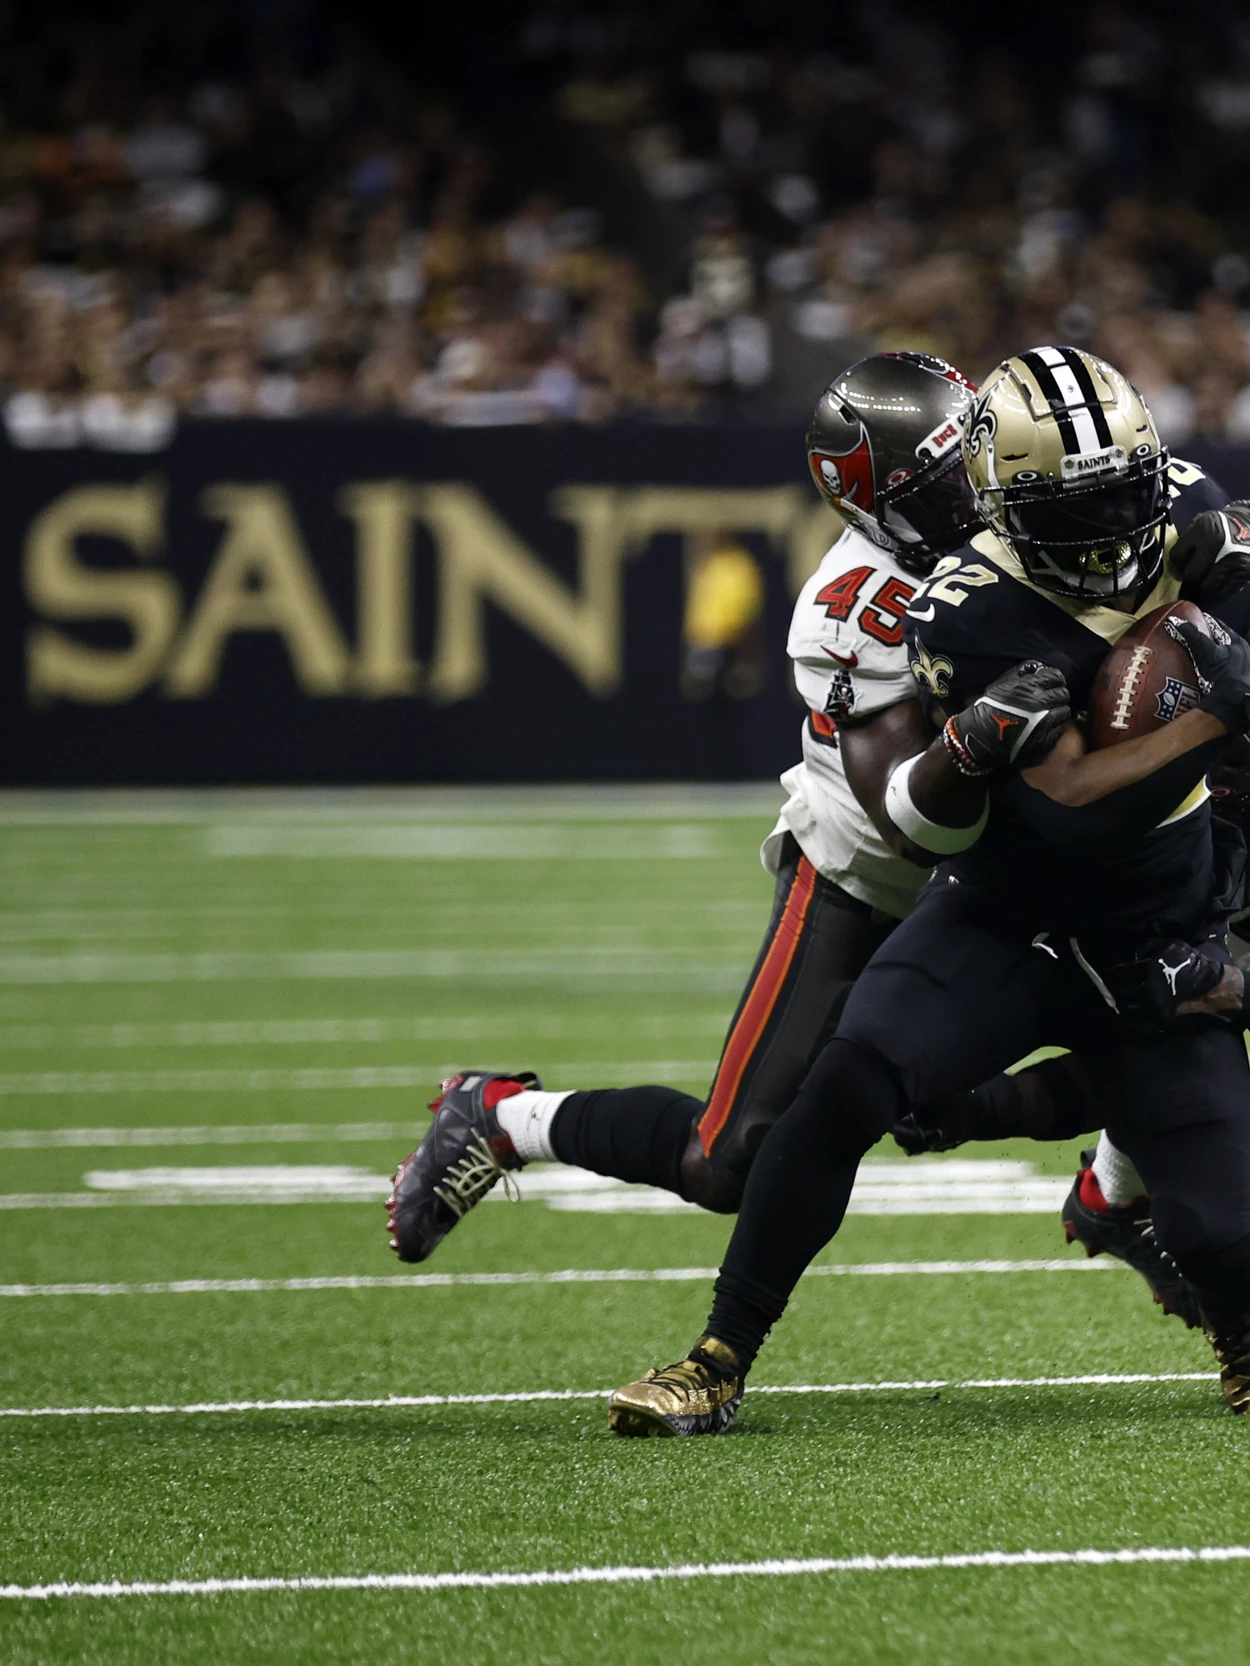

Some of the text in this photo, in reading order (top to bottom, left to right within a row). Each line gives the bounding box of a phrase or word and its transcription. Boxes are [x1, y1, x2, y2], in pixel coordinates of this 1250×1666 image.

[1077, 454, 1111, 471] SAINTS
[22, 476, 846, 706] SAINT
[813, 565, 917, 647] 45
